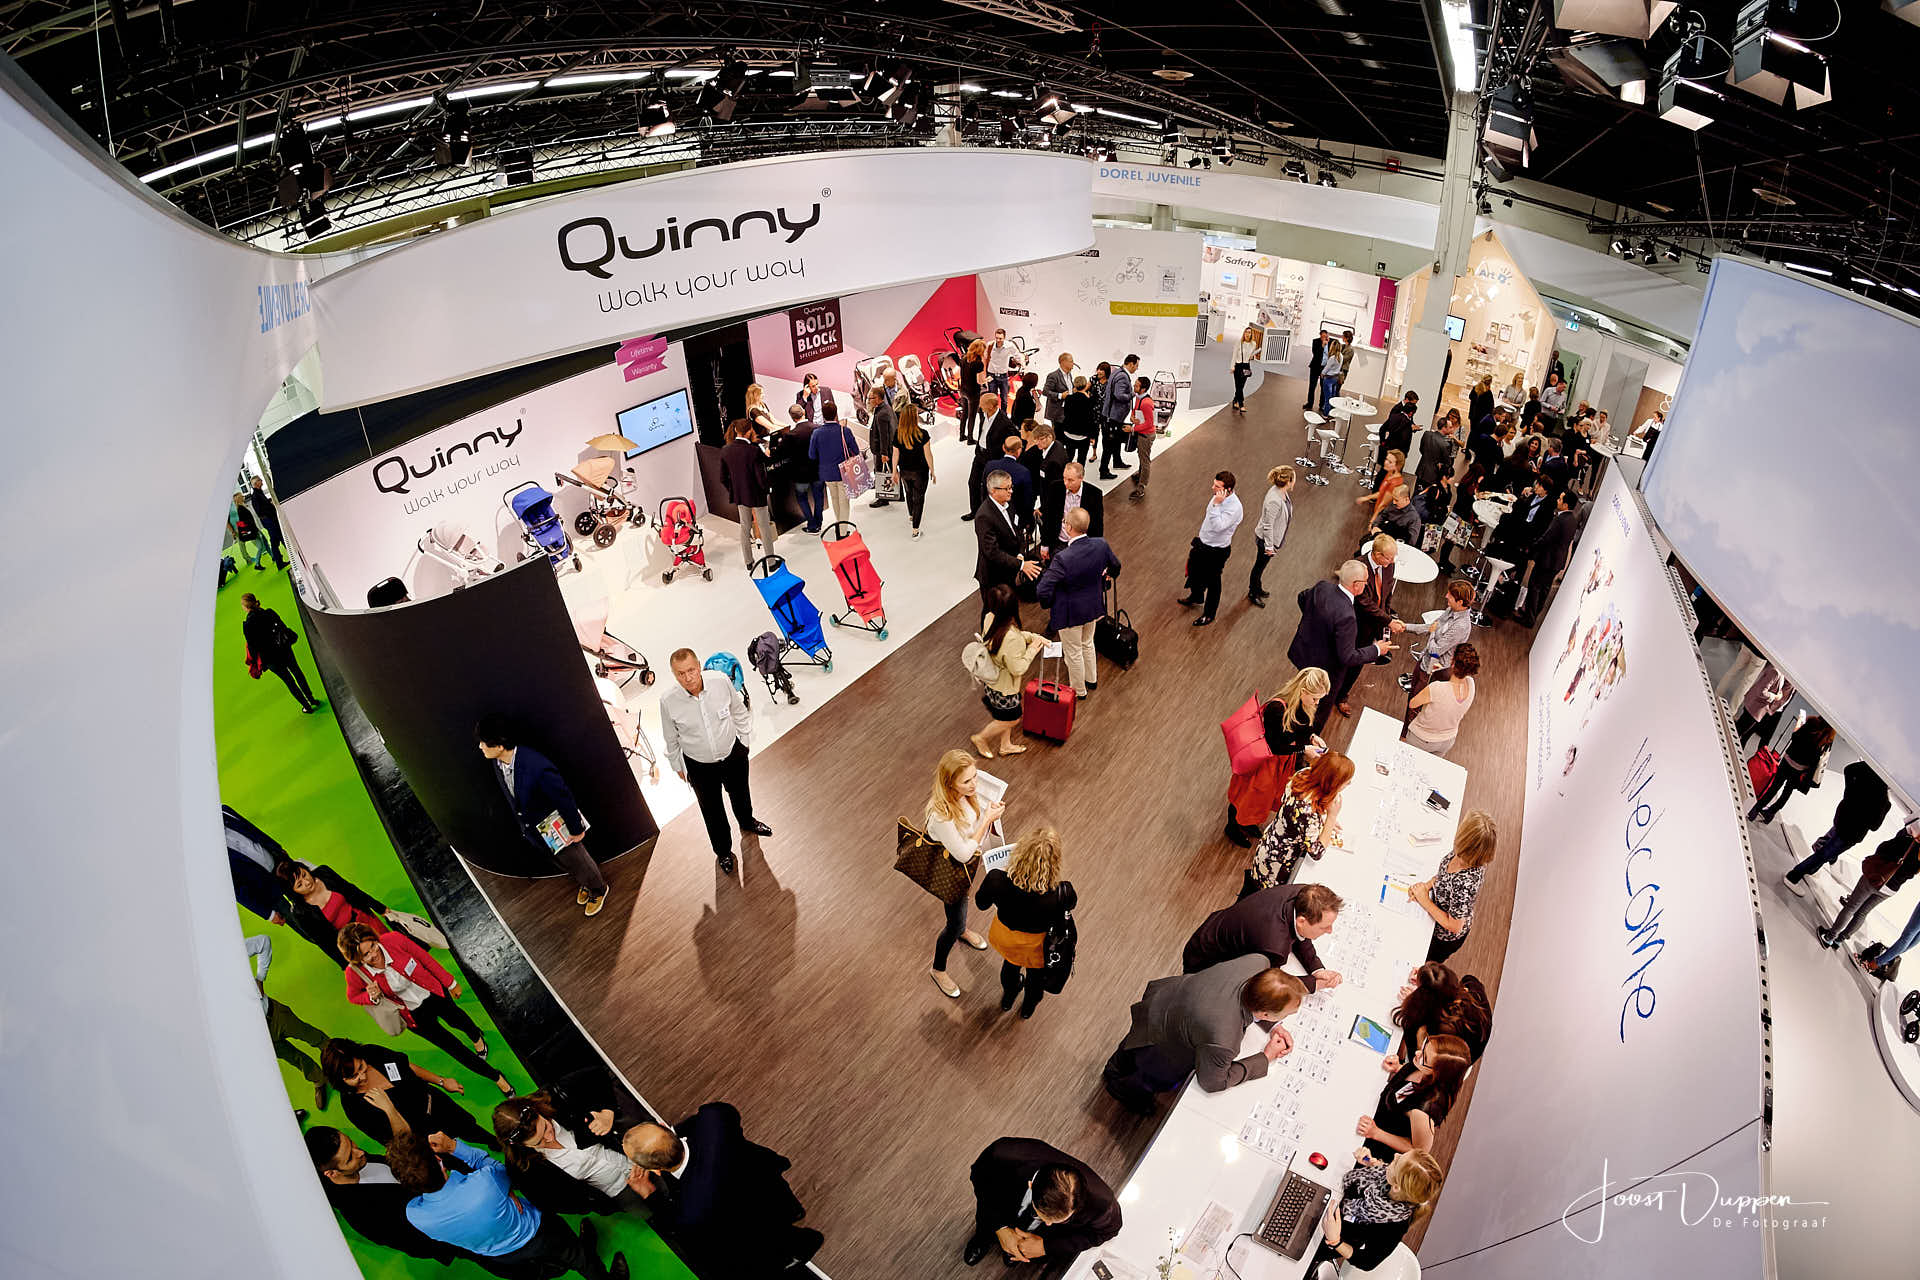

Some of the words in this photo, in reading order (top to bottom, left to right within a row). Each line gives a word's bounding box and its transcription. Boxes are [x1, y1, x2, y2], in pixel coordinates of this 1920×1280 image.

[1100, 167, 1143, 181] DOREL
[1146, 171, 1201, 187] JUVENILE
[558, 203, 821, 279] Quinny
[1224, 255, 1257, 269] Safety
[675, 268, 738, 299] your
[746, 257, 806, 282] way
[795, 311, 836, 337] BOLD
[630, 345, 655, 358] Lifetime
[797, 330, 837, 353] BLOCK
[799, 350, 819, 360] SPECIAL
[819, 343, 838, 353] EDITION
[631, 361, 658, 376] Warranty
[373, 418, 523, 494] Quinny
[448, 469, 482, 495] your
[485, 454, 521, 477] way
